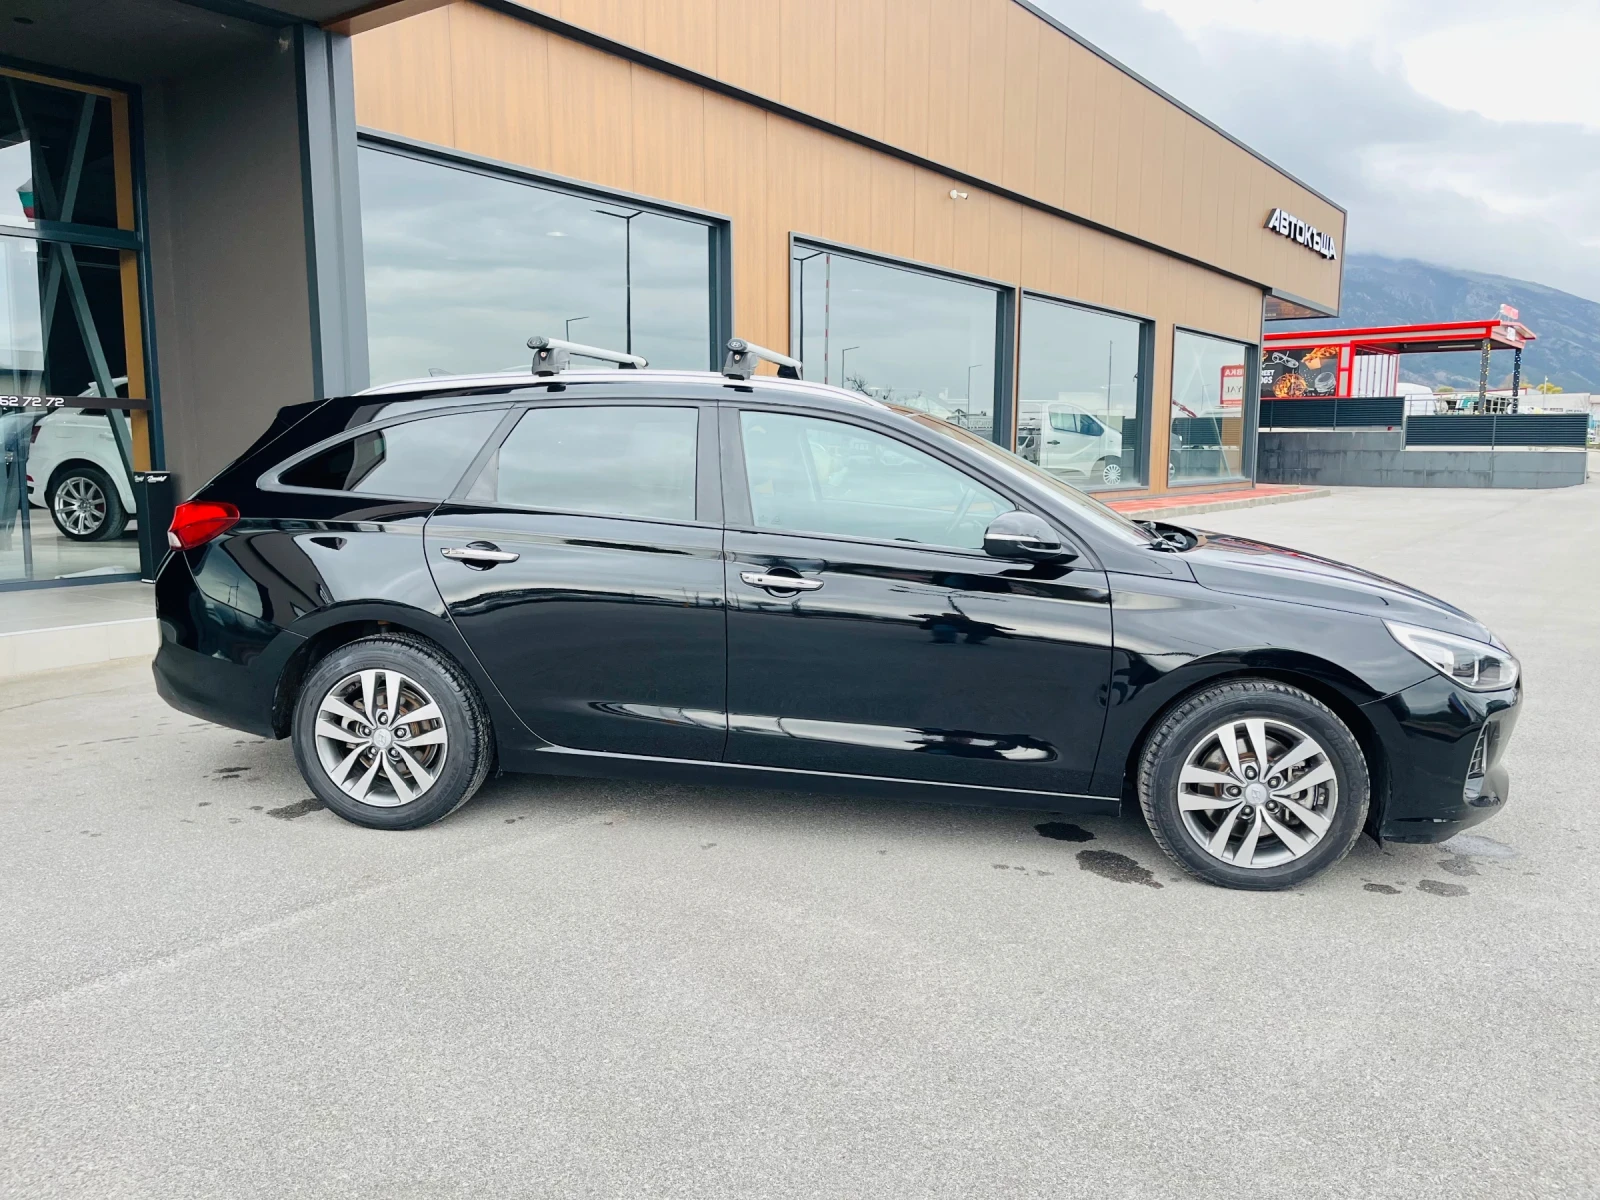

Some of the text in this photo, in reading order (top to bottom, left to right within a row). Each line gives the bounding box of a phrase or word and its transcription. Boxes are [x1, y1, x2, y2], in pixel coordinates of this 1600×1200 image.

[1266, 208, 1337, 260] АВТОКЪЩА
[23, 397, 42, 407] 72
[46, 398, 65, 407] 72
